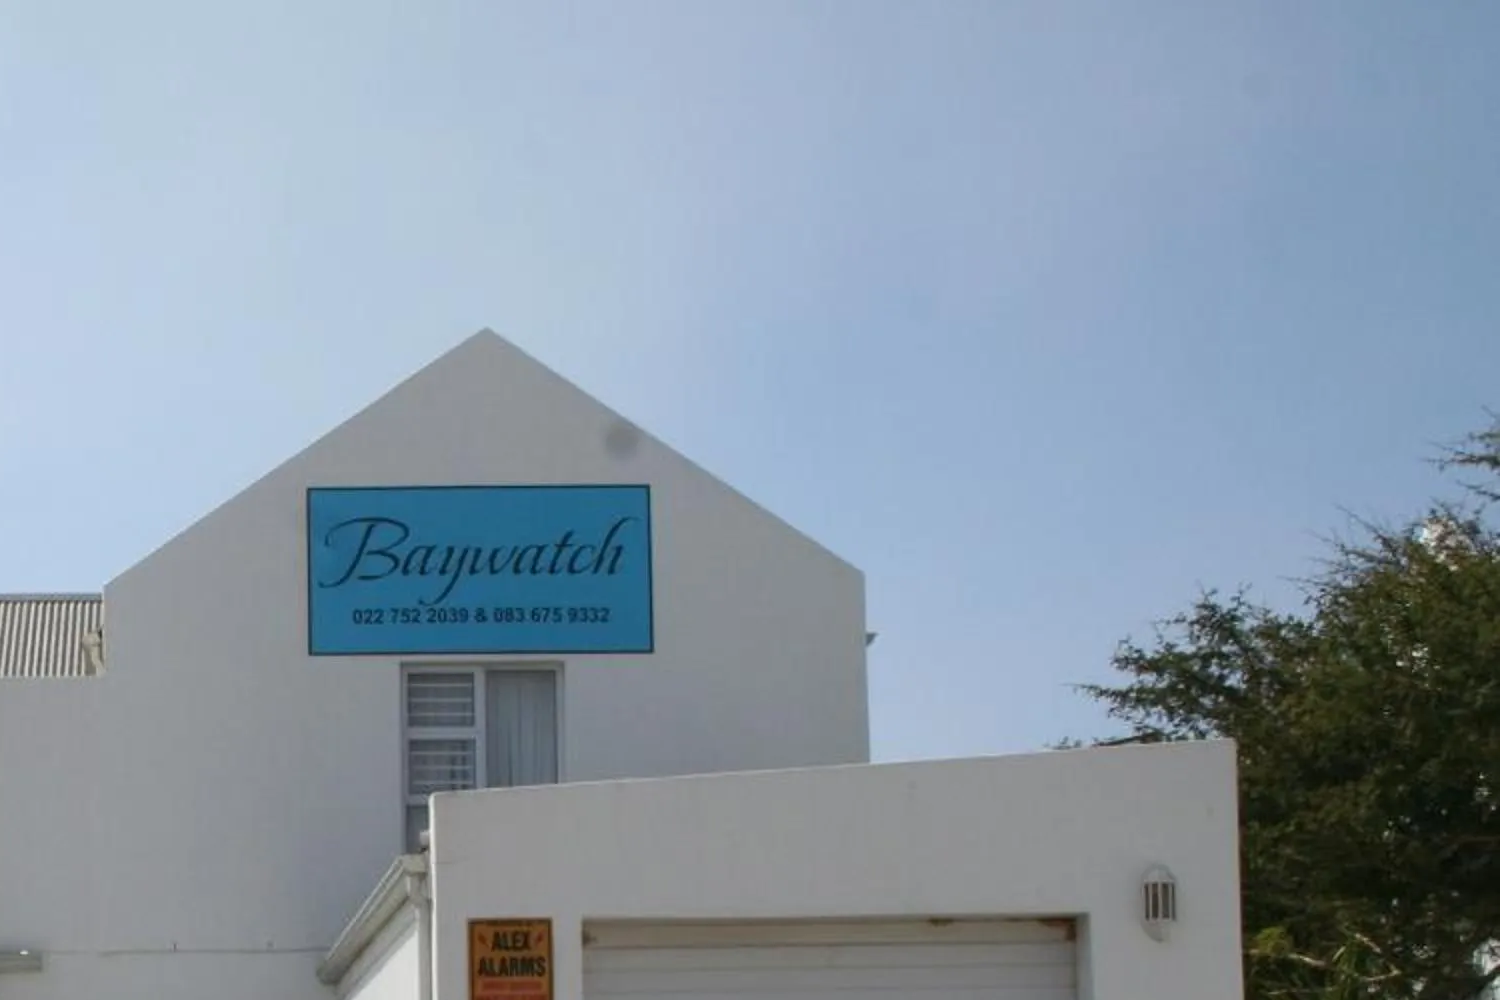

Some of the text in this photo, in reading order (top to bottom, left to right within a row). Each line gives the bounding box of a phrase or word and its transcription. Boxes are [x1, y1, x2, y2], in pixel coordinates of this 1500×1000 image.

[318, 515, 642, 606] Baywatch
[352, 606, 611, 626] 022 752 2039 & 083 675 9332
[491, 931, 532, 952] ALEX
[478, 956, 547, 977] ALARMS
